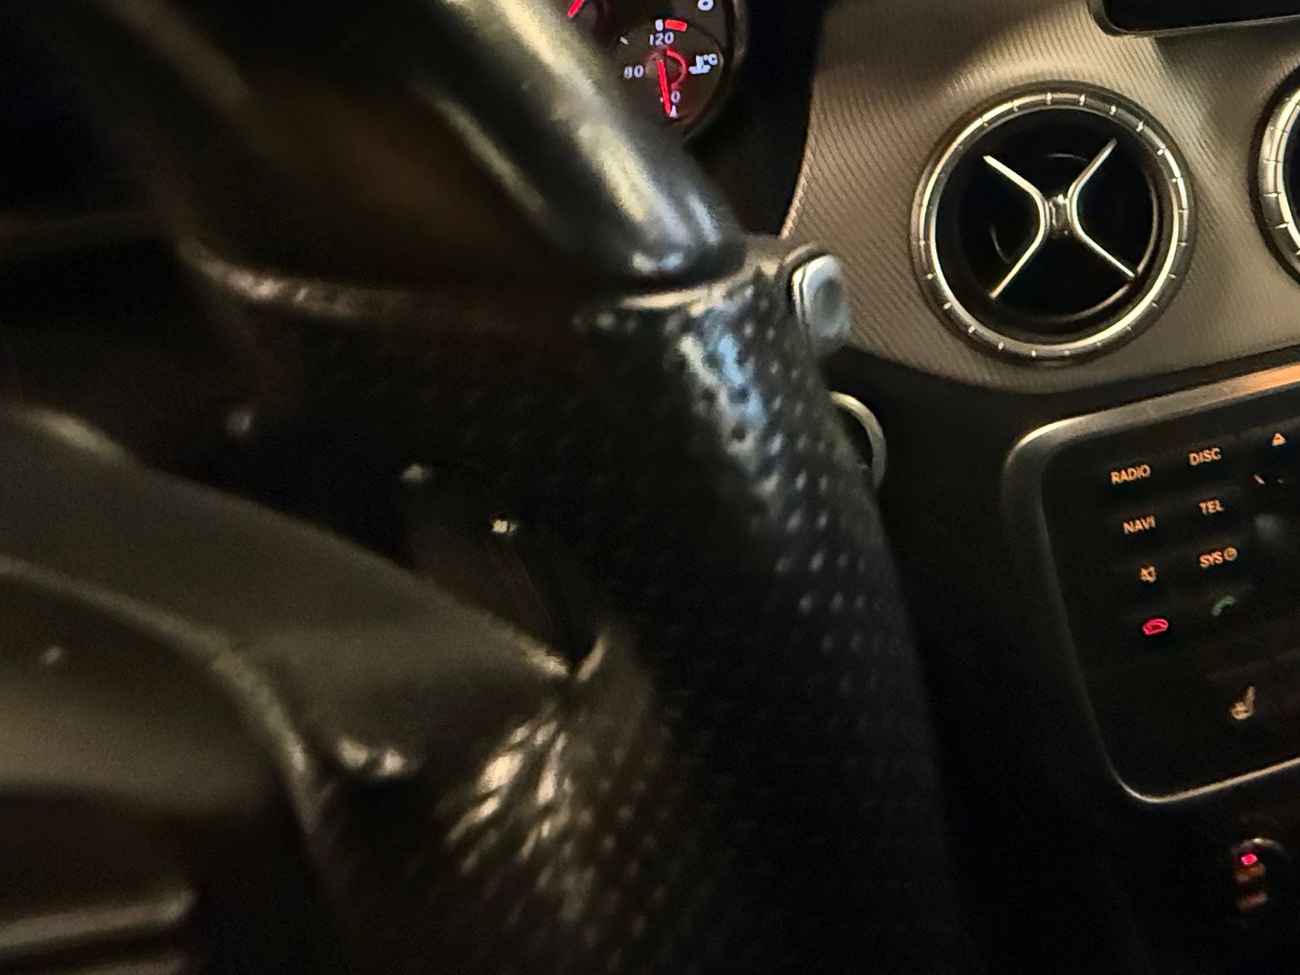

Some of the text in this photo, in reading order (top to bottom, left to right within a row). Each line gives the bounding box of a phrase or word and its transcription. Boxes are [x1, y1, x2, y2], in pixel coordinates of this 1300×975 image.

[650, 32, 674, 45] 120
[1189, 447, 1221, 465] DISC
[1111, 465, 1151, 484] RADIO
[1200, 500, 1224, 515] TEL
[1123, 515, 1156, 534] NAVI
[1200, 551, 1224, 568] SYS
